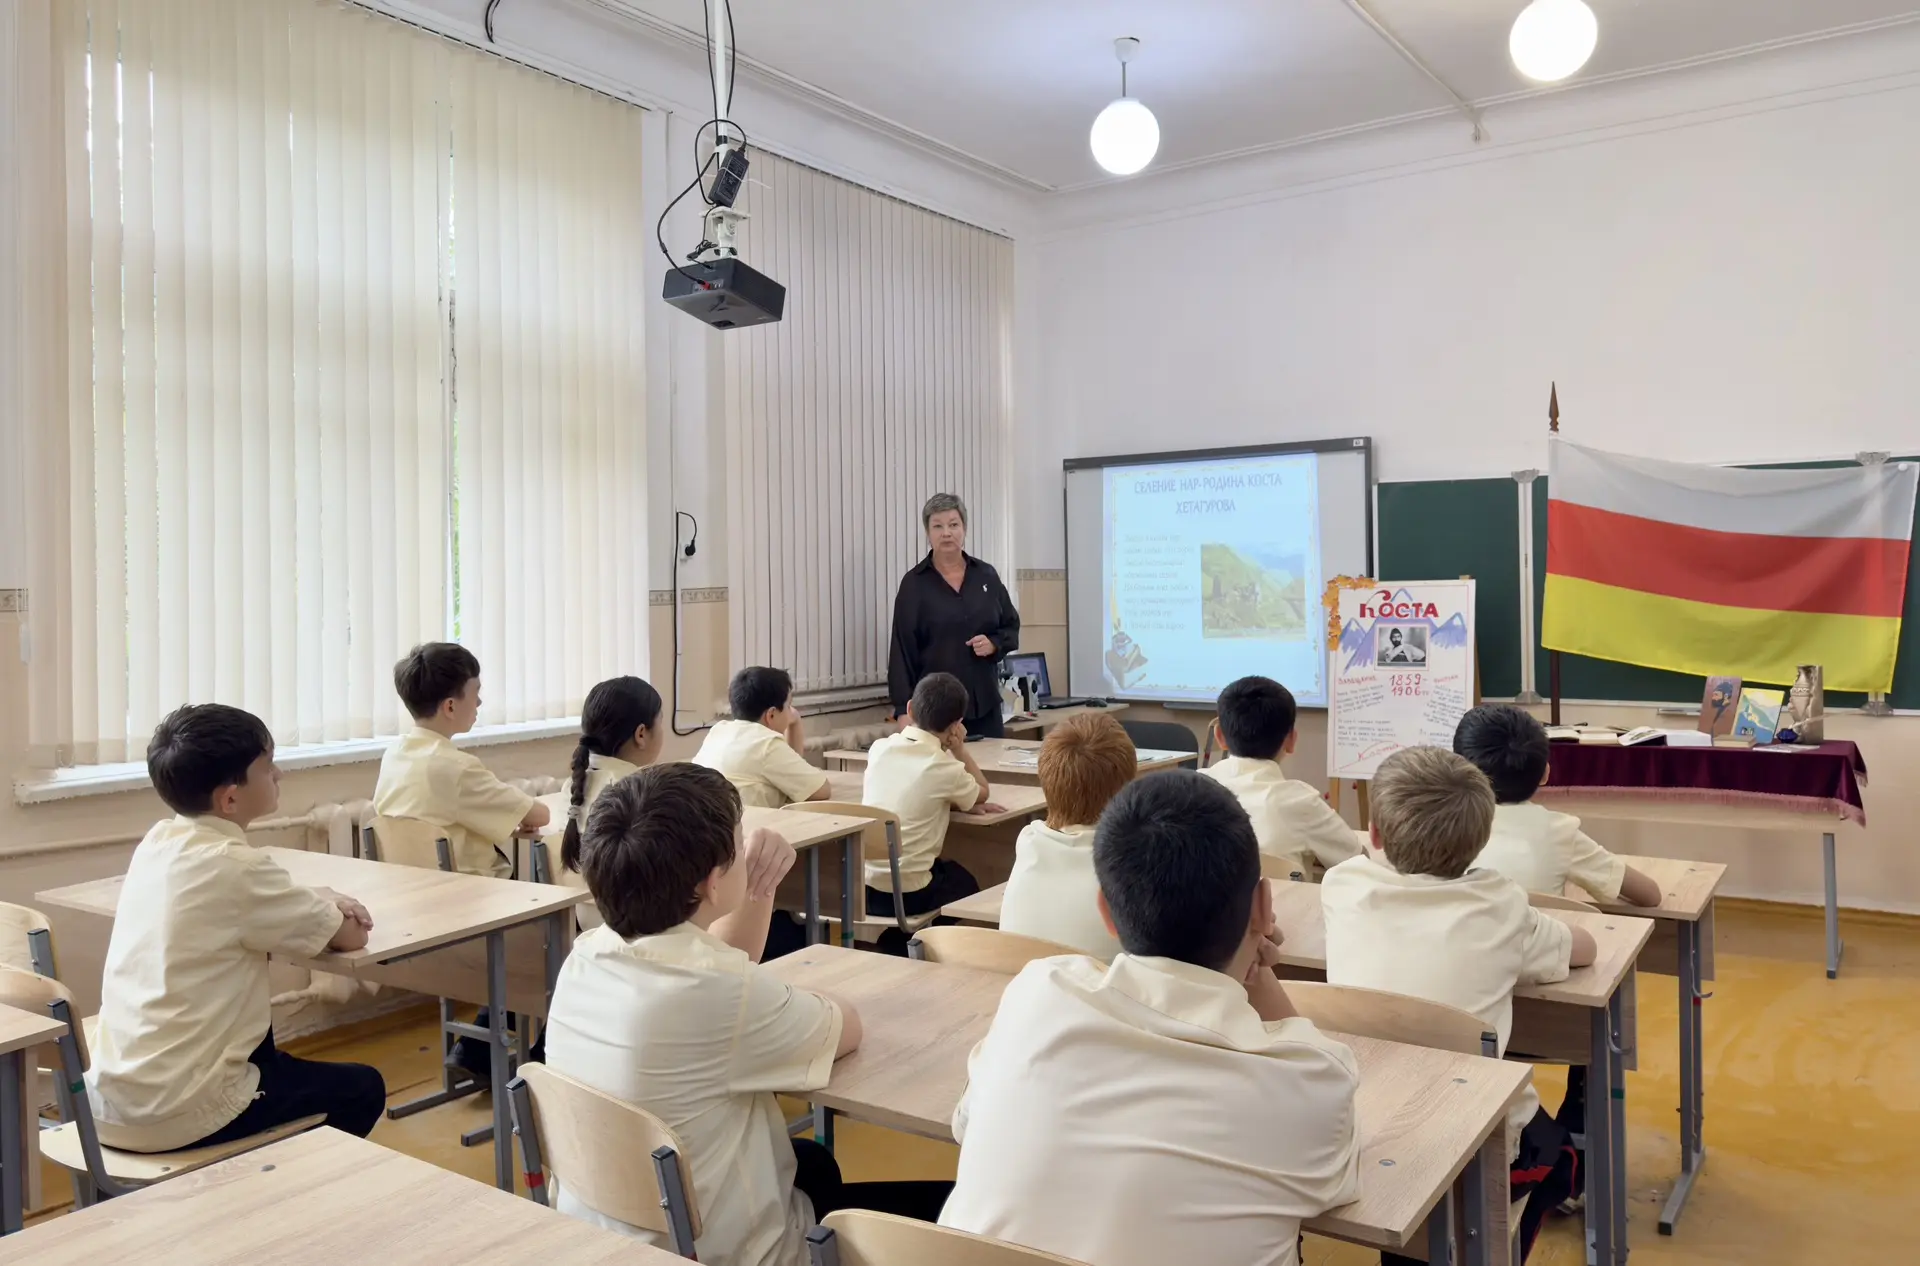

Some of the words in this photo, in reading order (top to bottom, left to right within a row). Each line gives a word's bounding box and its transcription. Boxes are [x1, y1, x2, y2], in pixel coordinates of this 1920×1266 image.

[1134, 478, 1177, 494] СЕЛЕНИЕ
[1247, 472, 1283, 488] КОСТА
[1175, 498, 1236, 515] ХЕТАГУРОВА
[1359, 590, 1440, 618] КОСТА
